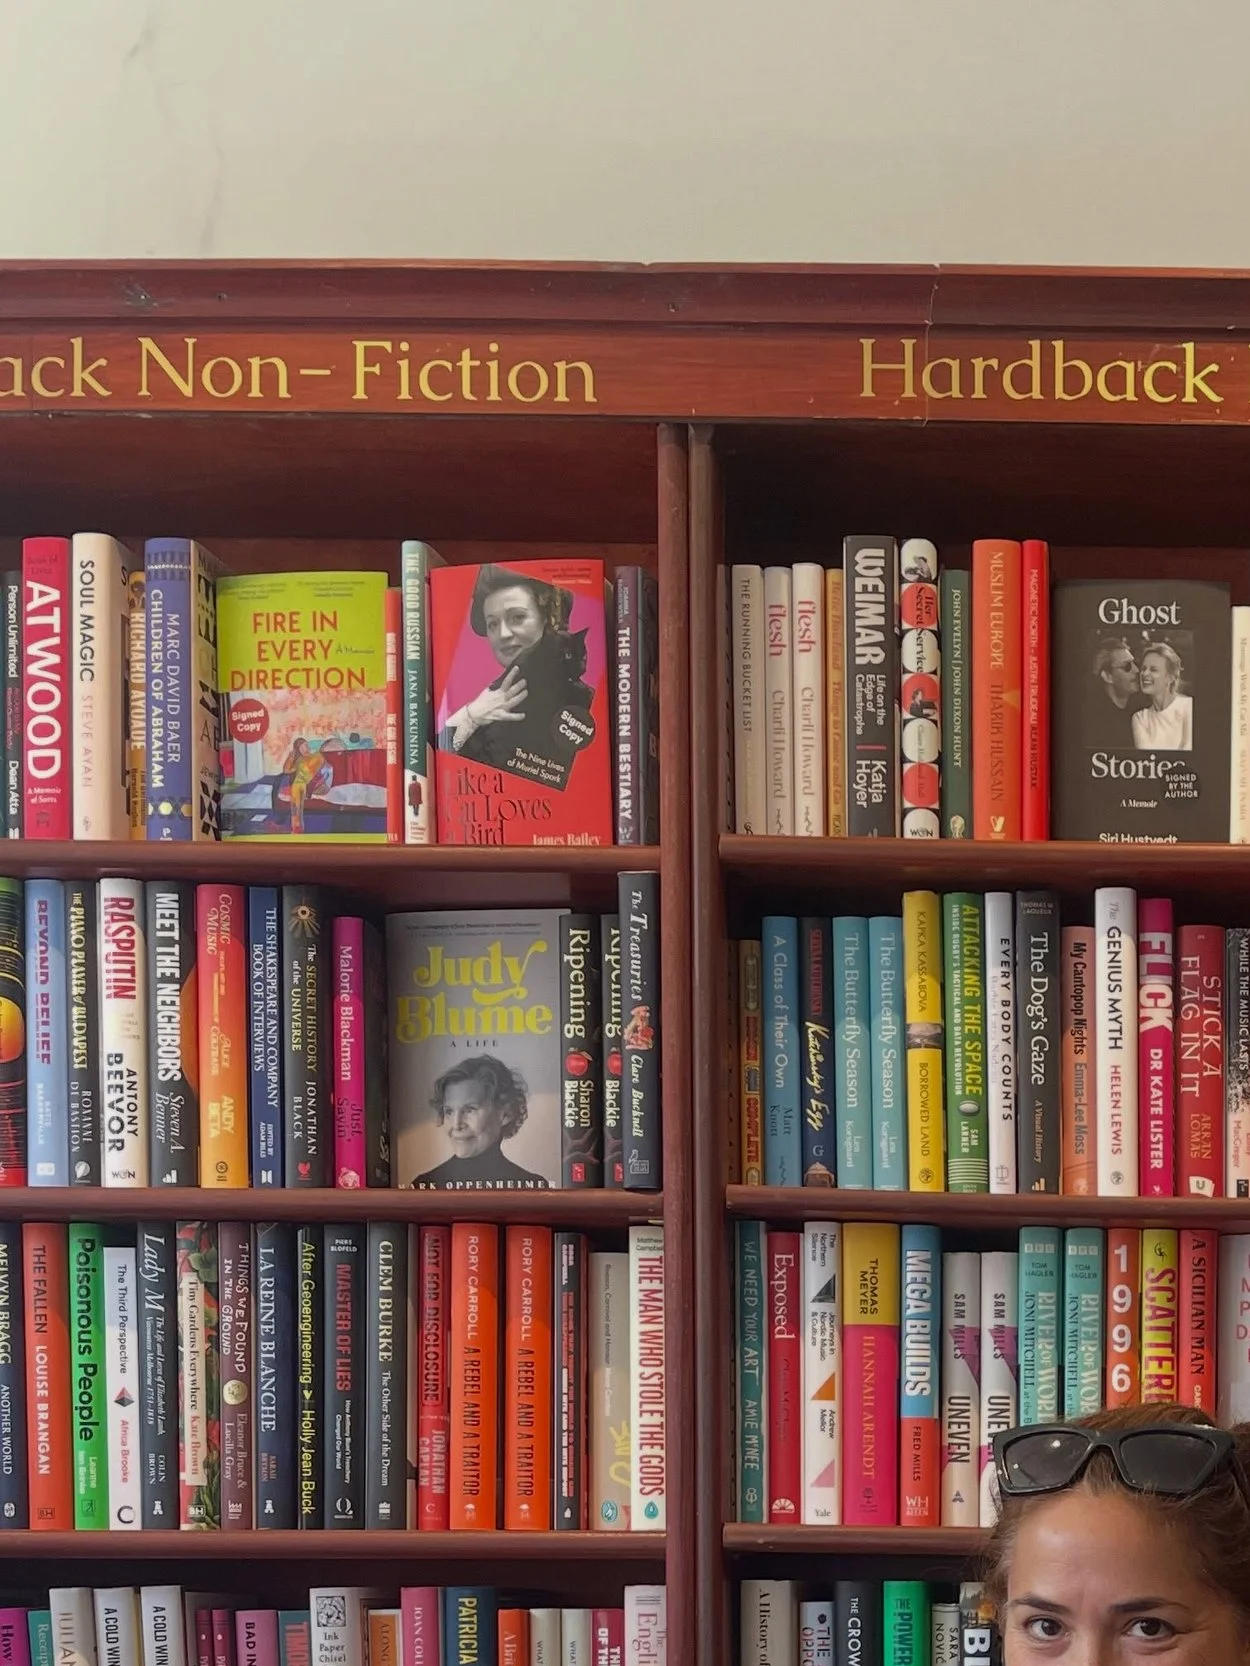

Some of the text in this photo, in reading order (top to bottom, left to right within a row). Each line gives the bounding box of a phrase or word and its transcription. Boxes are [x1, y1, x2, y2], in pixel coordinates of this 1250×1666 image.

[858, 337, 1224, 403] Hardback
[252, 610, 338, 634] FIRE IN
[854, 548, 886, 666] WEIMAR
[1098, 598, 1180, 626] Ghost
[26, 580, 61, 780] ATWOOD
[230, 667, 365, 691] DIRECTION
[257, 640, 332, 662] EVERY
[231, 709, 265, 724] Signed
[237, 719, 262, 734] Copy
[104, 897, 137, 1000] RASPUTIN
[414, 940, 548, 1006] Judy
[565, 927, 591, 1039] Ripening
[1139, 933, 1173, 1032] FLICK
[396, 991, 553, 1042] Blume
[1106, 926, 1123, 1050] GENIUS MYTH
[106, 1053, 125, 1153] BEEVOR
[126, 1068, 138, 1137] ANTONY
[773, 1252, 794, 1340] Exposed
[904, 1250, 930, 1397] MEGA BUILDS
[1111, 1245, 1132, 1393] 1996
[75, 1237, 99, 1441] Poisonous People
[948, 1396, 970, 1464] UNEVEN
[458, 1597, 479, 1664] PATRICIA
